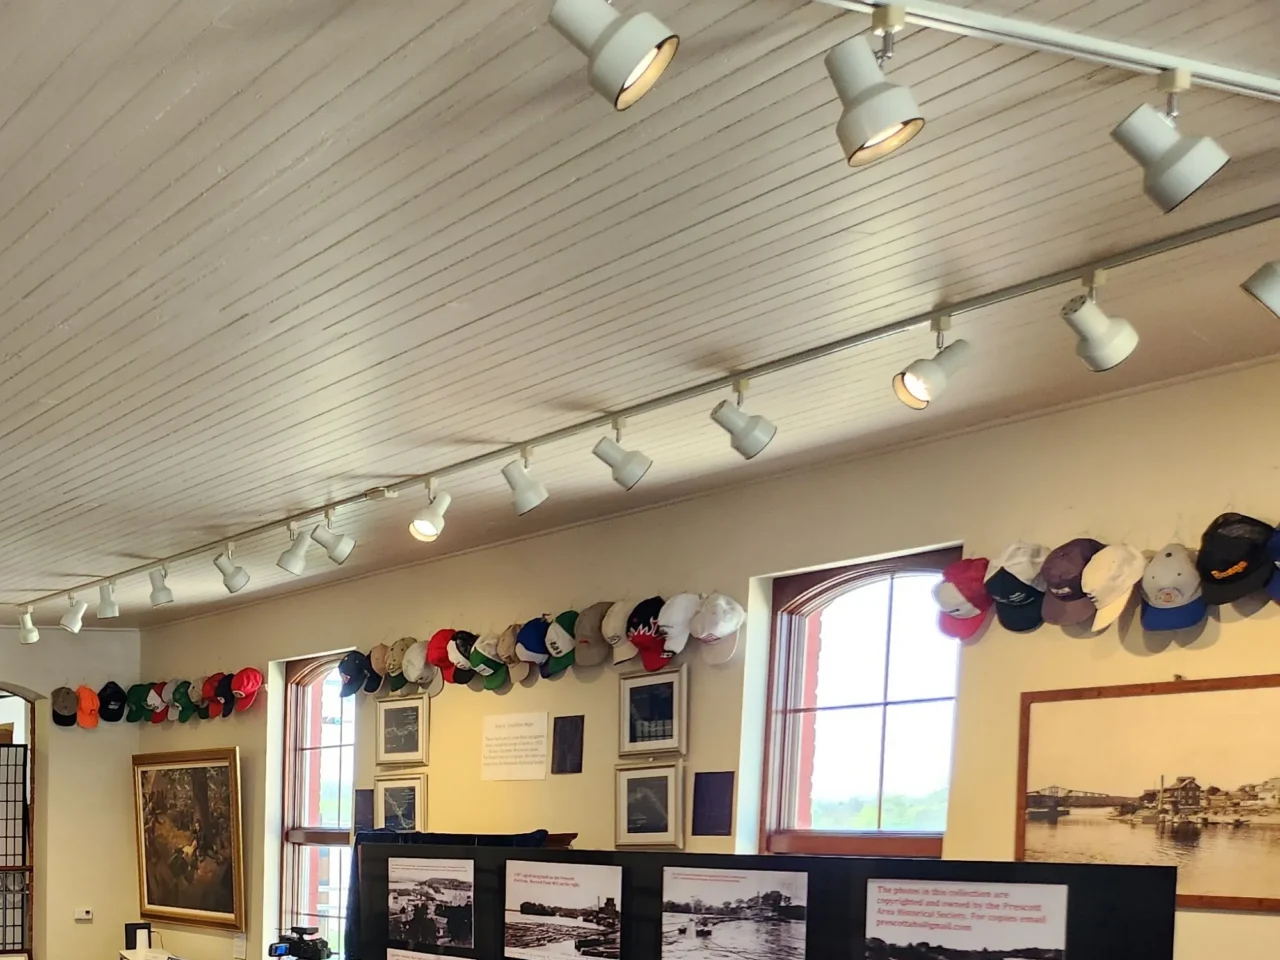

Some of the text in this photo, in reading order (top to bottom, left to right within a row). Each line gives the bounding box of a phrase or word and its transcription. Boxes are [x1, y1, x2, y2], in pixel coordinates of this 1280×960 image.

[877, 886, 892, 894] The
[893, 887, 920, 895] photos
[948, 889, 992, 897] collection
[876, 898, 923, 906] copyrighted
[973, 902, 983, 910] by
[985, 902, 1000, 910] the
[1003, 903, 1042, 912] Prescott
[970, 912, 985, 920] For
[988, 914, 1017, 923] copies
[1020, 915, 1046, 924] email
